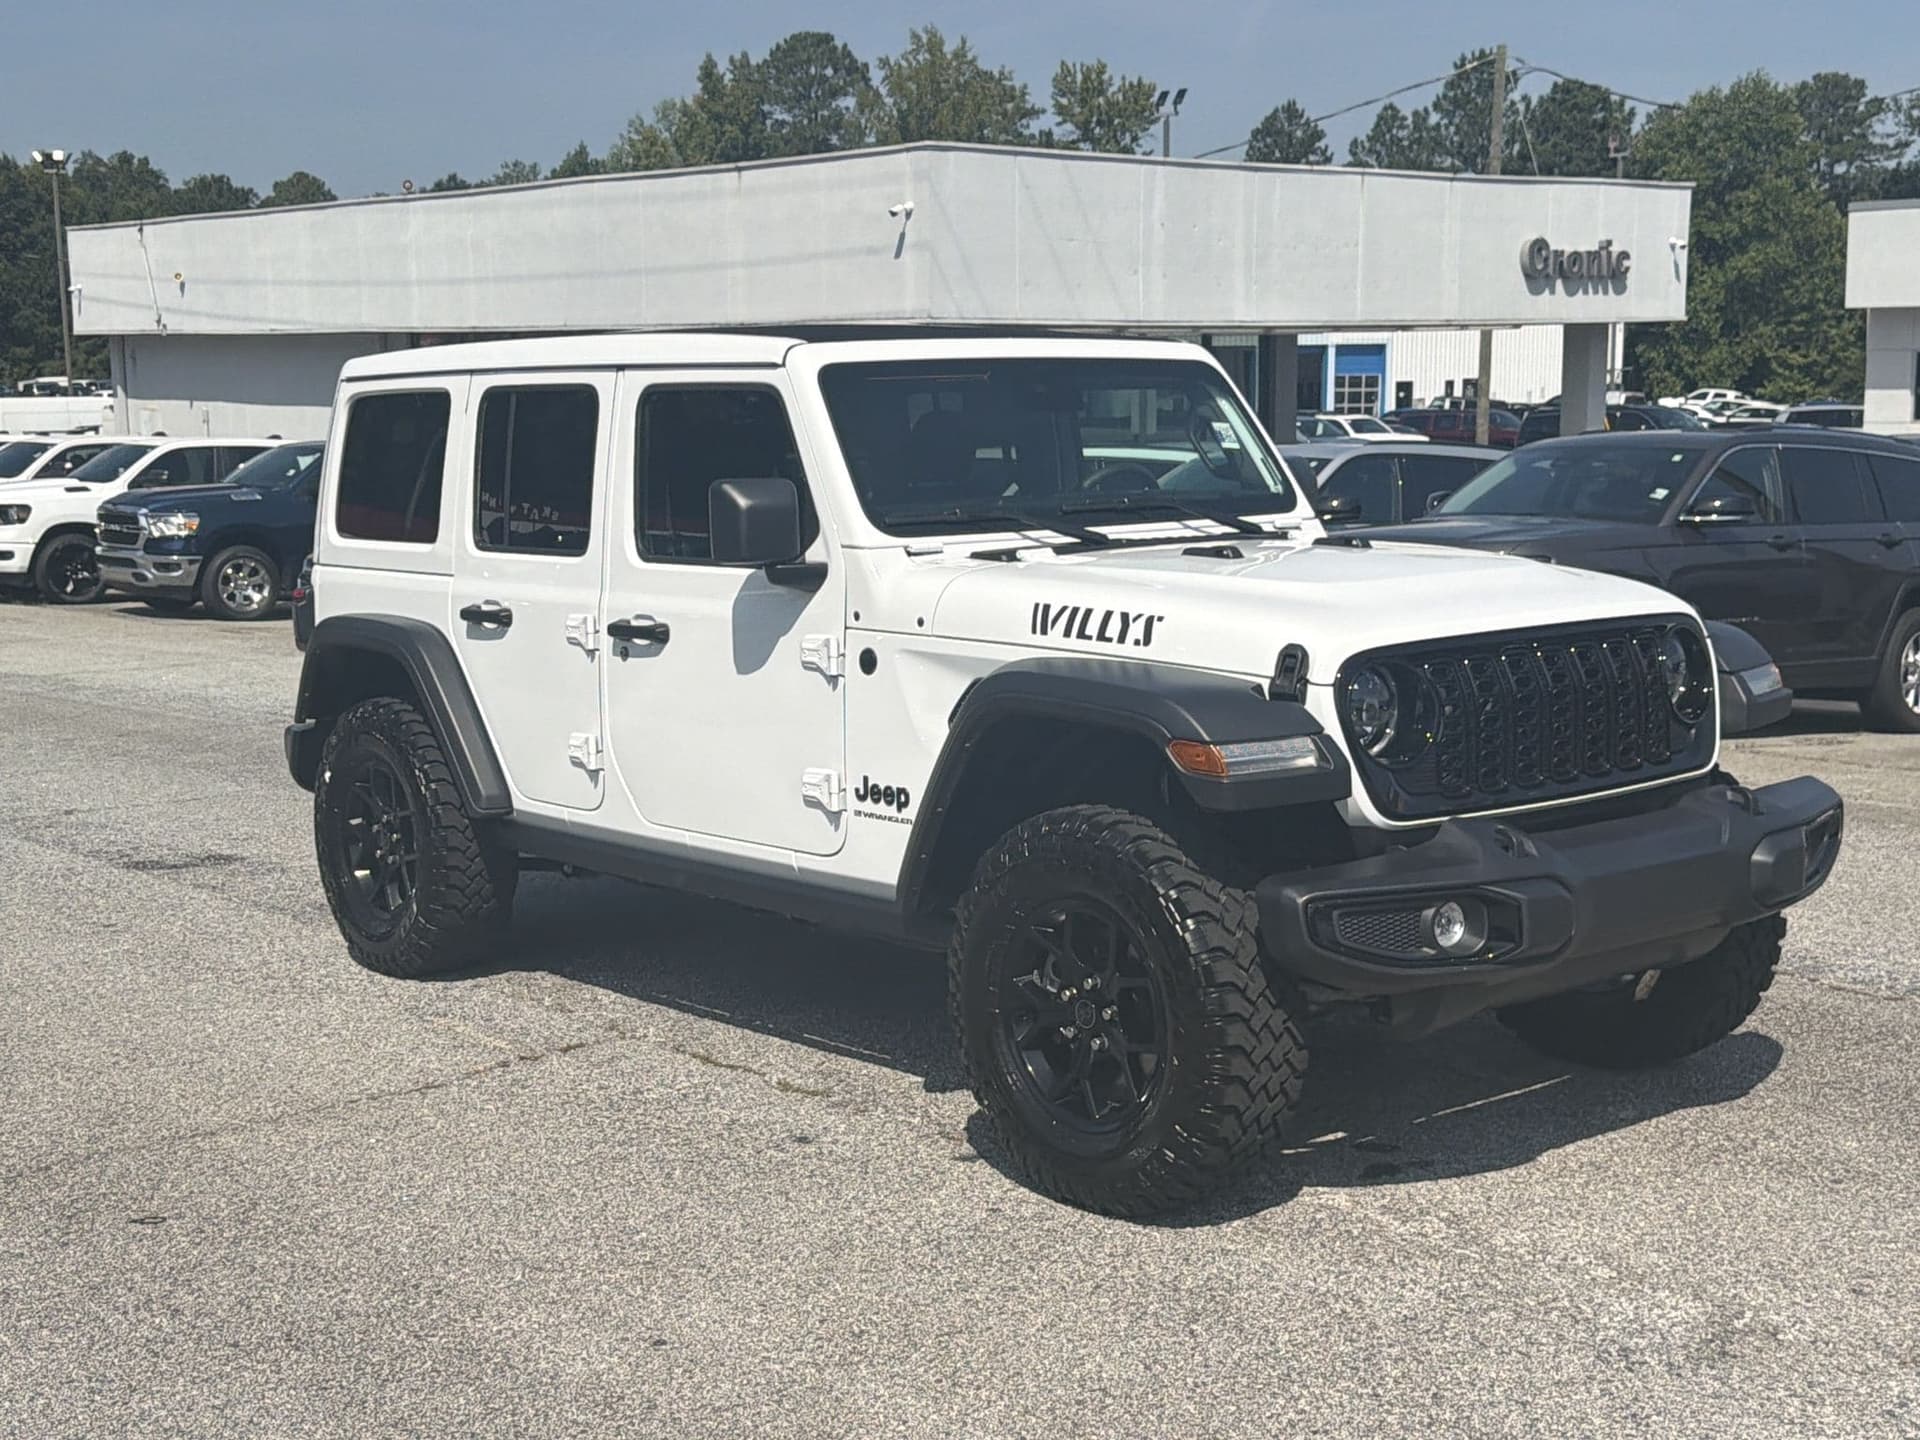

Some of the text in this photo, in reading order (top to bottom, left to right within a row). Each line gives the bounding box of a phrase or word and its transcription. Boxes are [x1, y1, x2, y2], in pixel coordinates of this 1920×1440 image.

[1520, 237, 1631, 279] Cronic
[1031, 602, 1165, 647] WILLYS
[854, 775, 910, 814] Jeep
